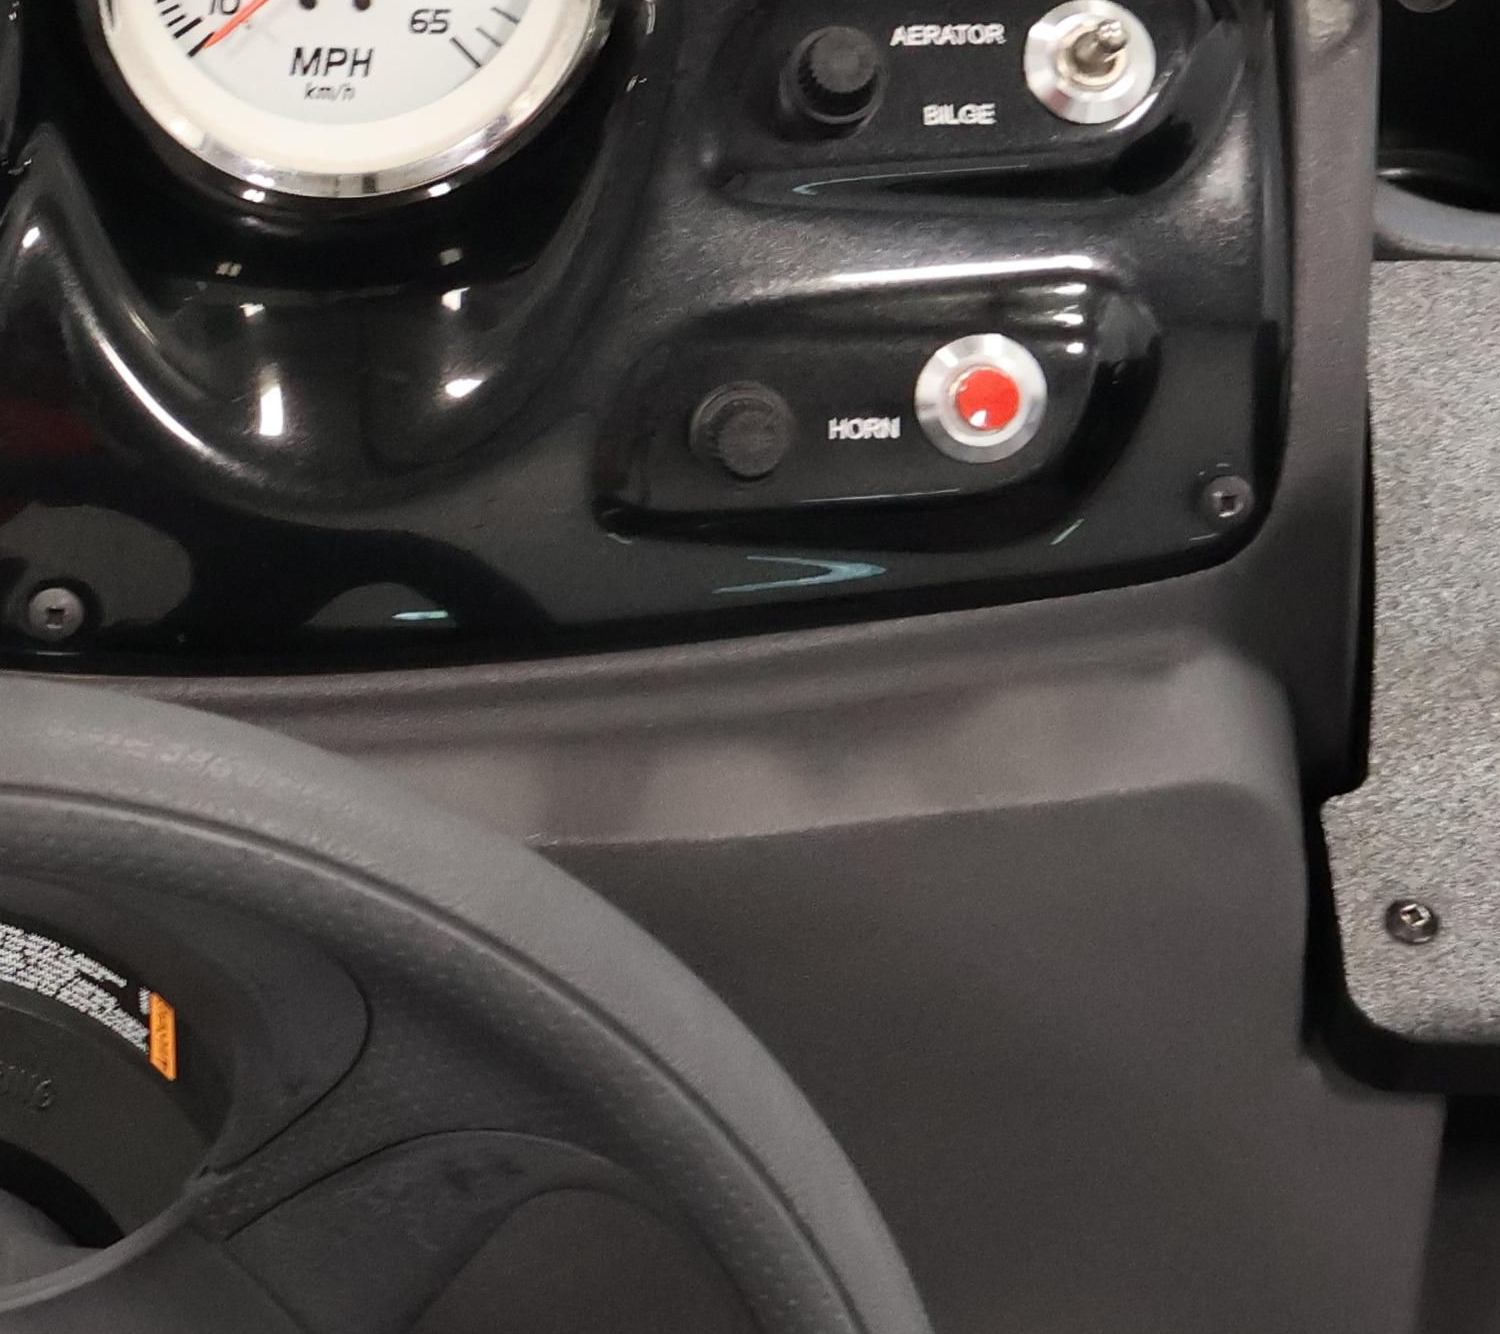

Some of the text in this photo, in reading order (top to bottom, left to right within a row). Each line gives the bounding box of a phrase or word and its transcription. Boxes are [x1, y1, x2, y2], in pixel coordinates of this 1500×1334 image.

[407, 9, 451, 35] 65
[889, 23, 1006, 46] AERATOR
[289, 47, 376, 78] MPH
[922, 104, 997, 126] BILGE
[828, 417, 900, 440] HORN
